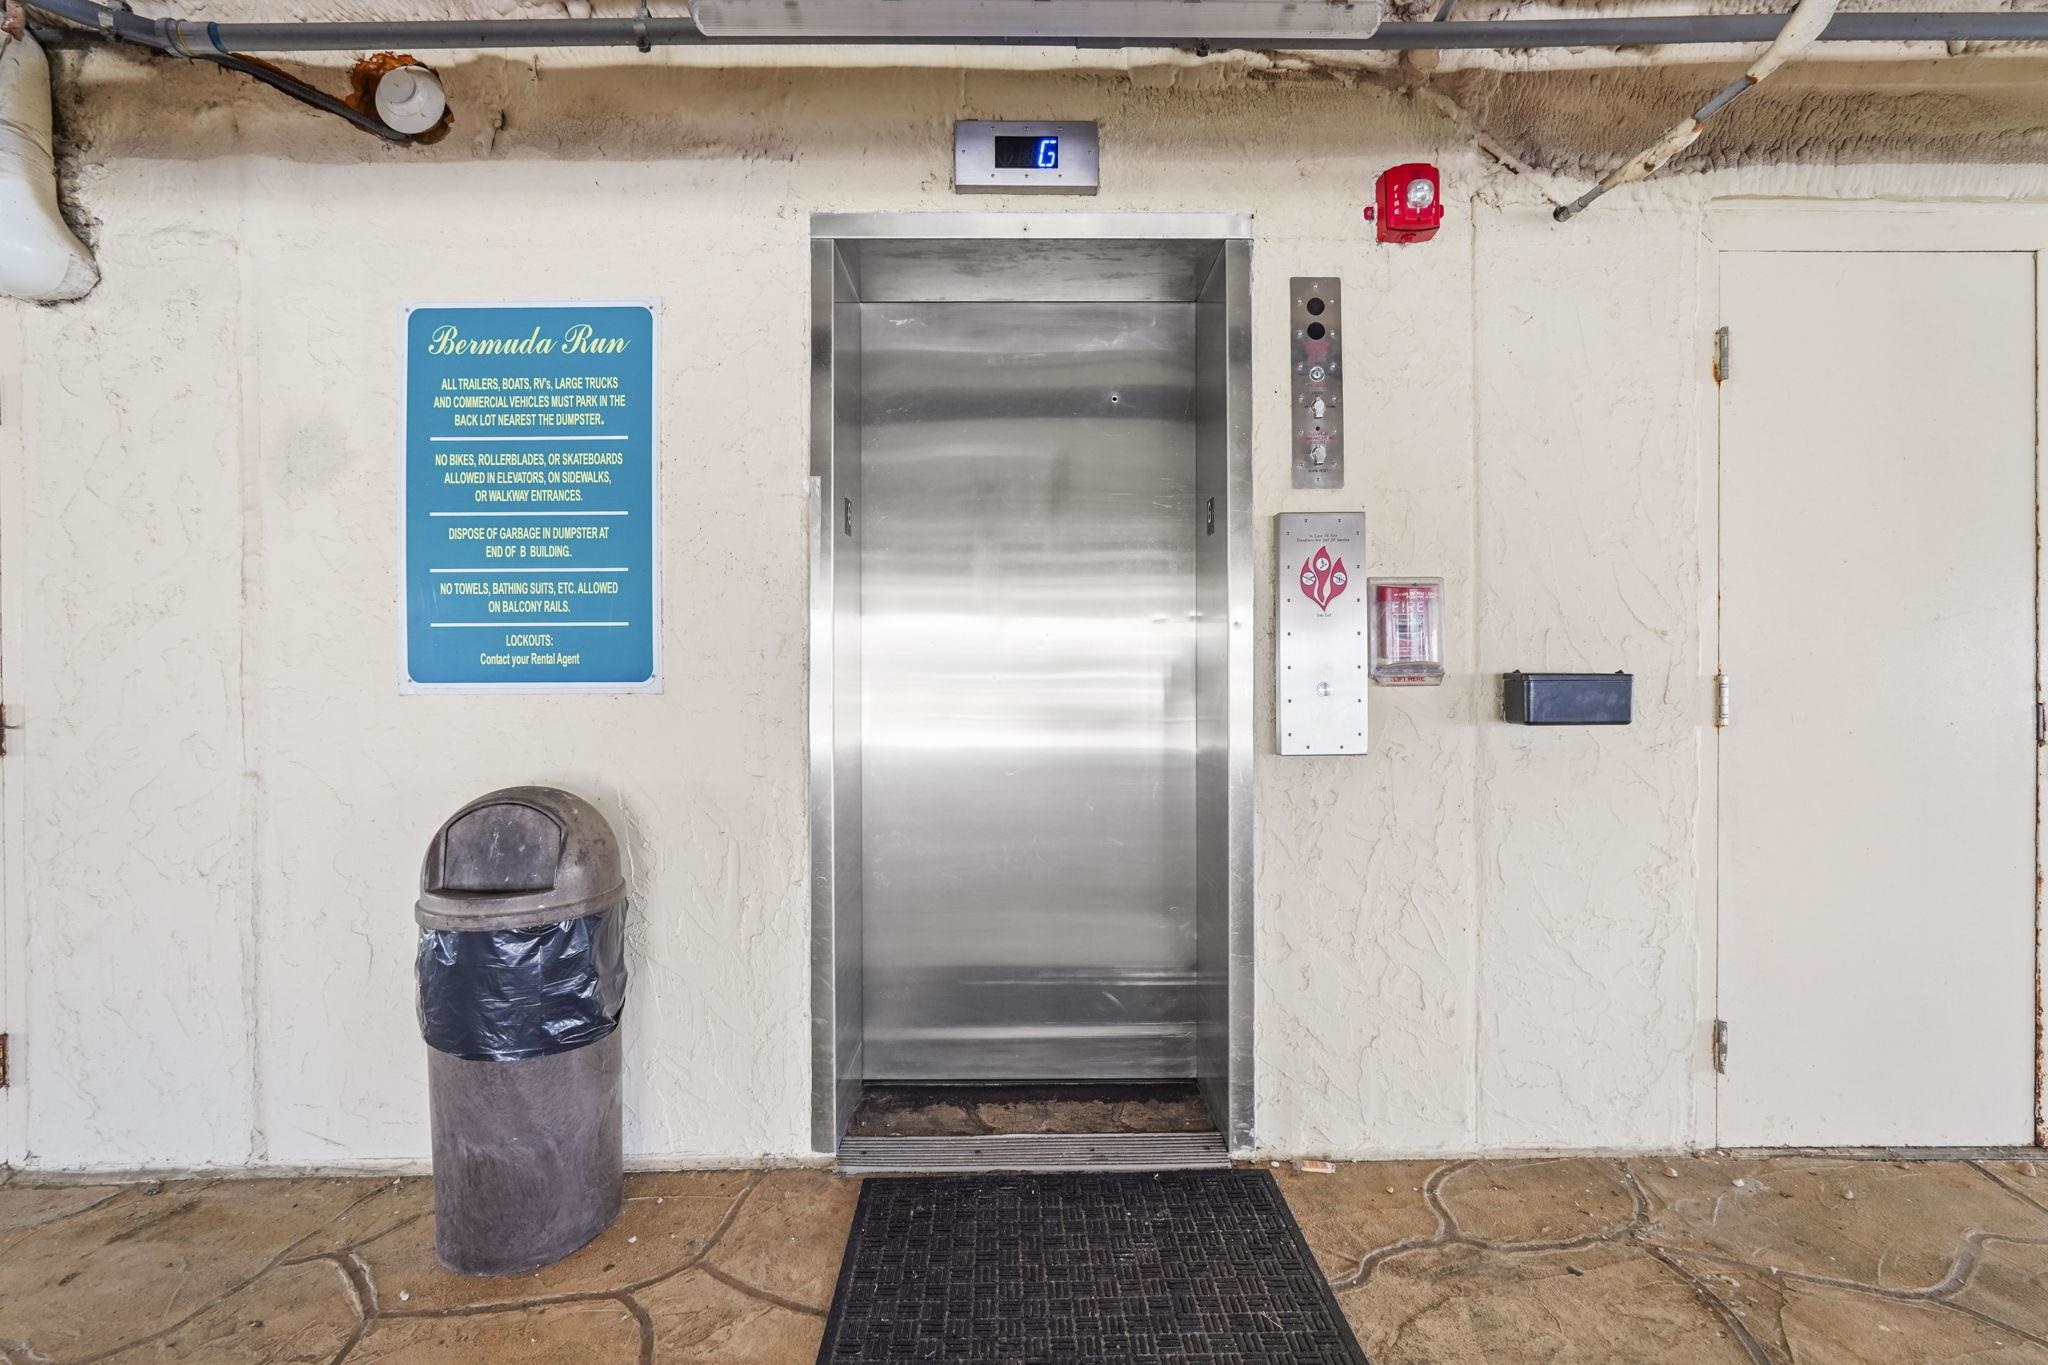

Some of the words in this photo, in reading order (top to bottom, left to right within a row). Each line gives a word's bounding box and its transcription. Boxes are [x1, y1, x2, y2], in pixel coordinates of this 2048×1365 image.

[1038, 140, 1056, 167] G
[428, 324, 557, 356] Bermuda
[561, 323, 630, 354] Run
[440, 378, 457, 391] ALL
[457, 377, 500, 392] TRAILERS,
[501, 377, 531, 391] BOATS,
[554, 376, 583, 390] LARGE
[584, 376, 618, 390] TRUCKS
[432, 395, 451, 409] AND
[452, 395, 508, 409] COMMERCIAL
[508, 395, 549, 408] VEHICLES
[550, 394, 574, 408] MUST
[575, 394, 597, 408] PARK
[599, 394, 607, 407] IN
[609, 394, 625, 407] THE
[454, 413, 478, 427] BACK
[479, 413, 496, 427] LOT
[497, 413, 536, 426] NEAREST
[537, 413, 554, 426] THE
[555, 412, 604, 426] DUMPSTER.
[434, 453, 448, 466] NO
[448, 453, 476, 468] BIKES,
[477, 453, 546, 467] ROLLERBLADES,
[547, 452, 560, 466] OR
[561, 452, 623, 466] SKATEBOARDS
[443, 471, 485, 485] ALLOWED
[486, 471, 495, 484] IN
[496, 471, 546, 486] ELEVATORS,
[547, 471, 560, 484] ON
[561, 470, 611, 485] SIDEWALKS,
[474, 489, 487, 503] OR
[488, 489, 529, 502] WALKWAY
[530, 488, 583, 502] ENTRANCES.
[448, 527, 484, 540] DISPOSE
[486, 527, 497, 540] OF
[499, 526, 540, 540] GARBAGE
[542, 527, 550, 540] IN
[552, 526, 598, 540] DUMPSTER
[598, 526, 609, 539] AT
[485, 545, 503, 558] END
[504, 545, 516, 558] OF
[519, 545, 526, 558] B
[529, 544, 572, 558] BUILDING.
[439, 582, 453, 595] NO
[453, 582, 490, 597] TOWELS,
[492, 582, 528, 595] BATHING
[529, 581, 556, 597] SUITS,
[557, 581, 576, 595] ETC.
[577, 581, 618, 595] ALLOWED
[487, 600, 500, 613] ON
[502, 600, 542, 613] BALCONY
[543, 599, 570, 613] RAILS.
[505, 633, 553, 647] LOCKOUTS:
[479, 652, 510, 665] Contact
[511, 655, 529, 668] your
[530, 652, 555, 665] Rental
[556, 652, 579, 668] Agent
